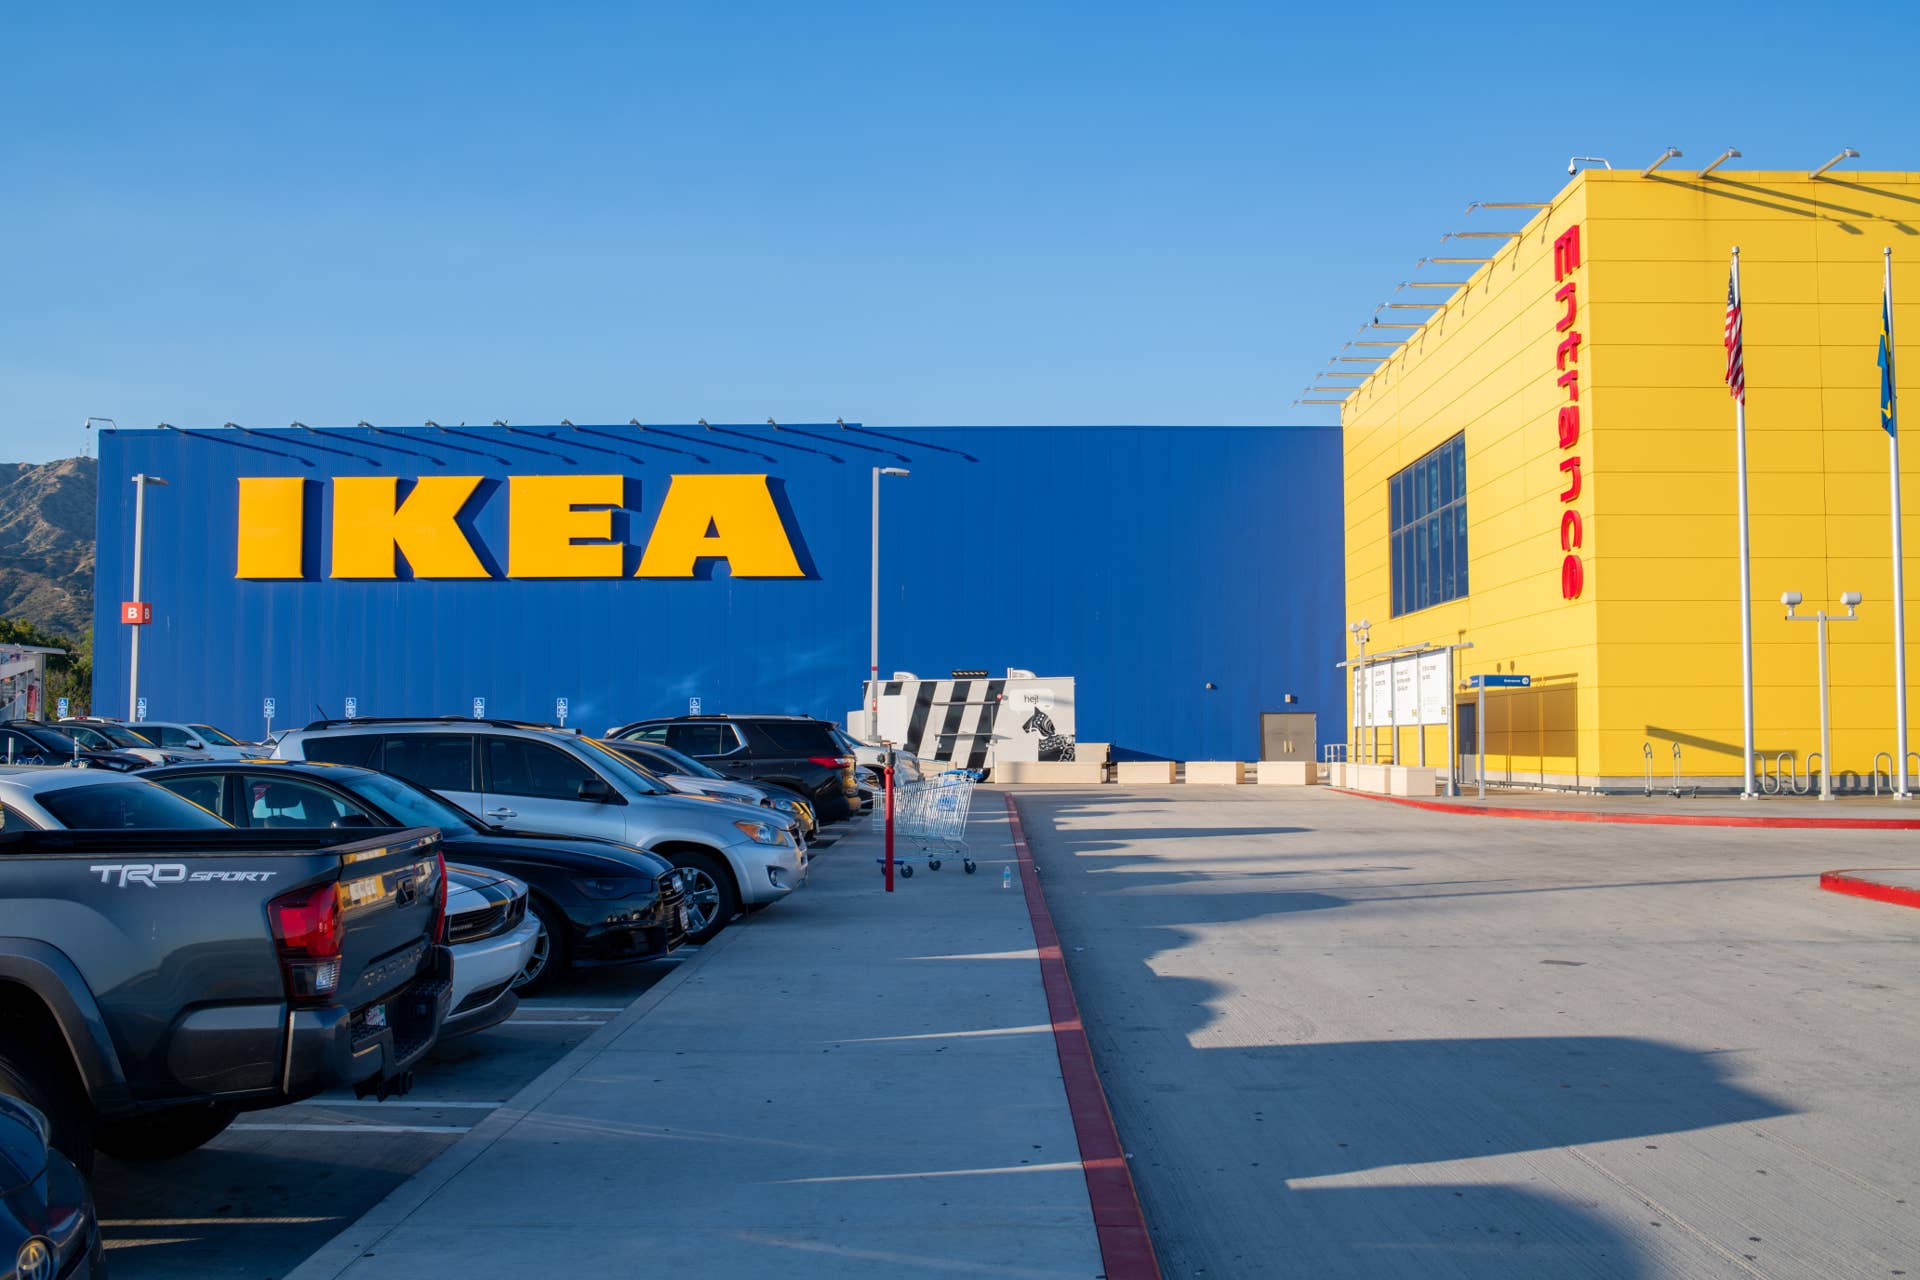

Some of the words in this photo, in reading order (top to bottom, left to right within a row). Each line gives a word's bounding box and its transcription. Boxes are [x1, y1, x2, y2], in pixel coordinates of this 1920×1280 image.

[1554, 224, 1584, 600] Entrance
[235, 474, 805, 578] IKEA
[127, 607, 138, 619] B
[144, 607, 151, 619] B
[1023, 694, 1039, 704] hej!
[90, 863, 188, 889] TRD
[188, 871, 277, 882] SPORT
